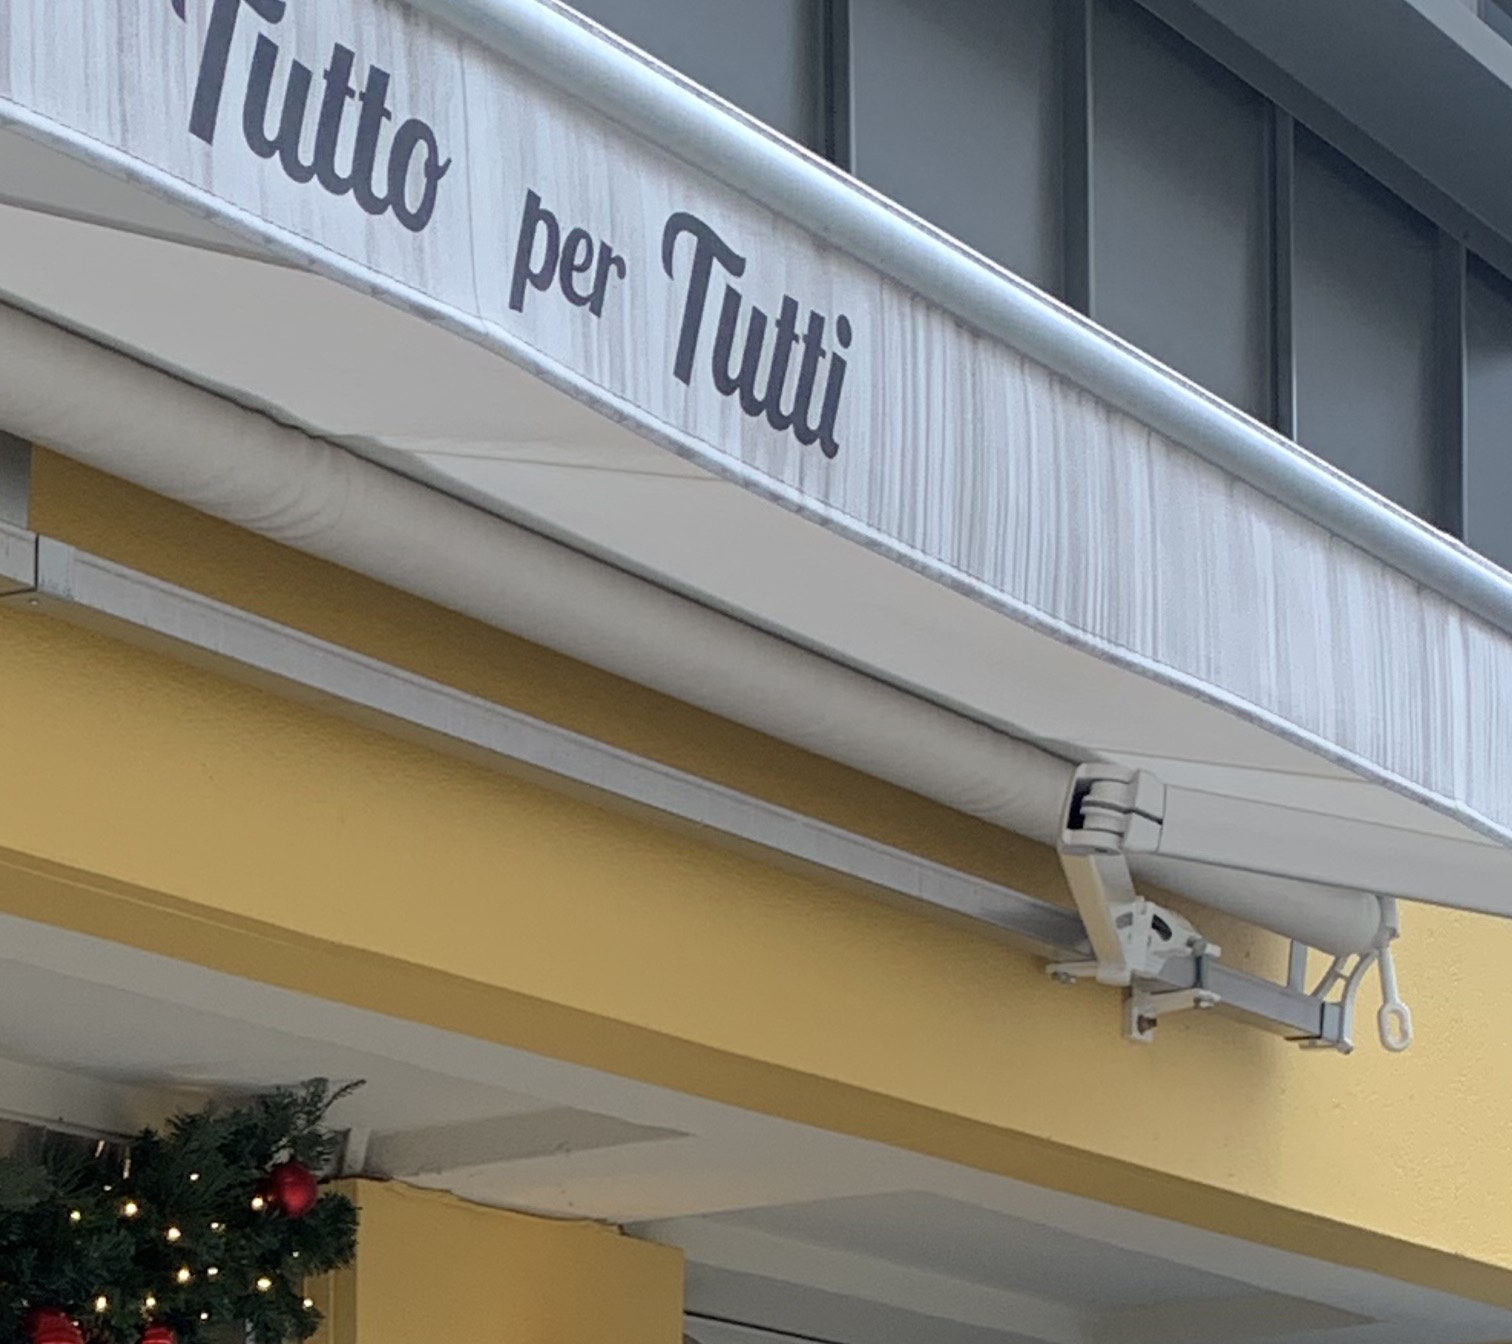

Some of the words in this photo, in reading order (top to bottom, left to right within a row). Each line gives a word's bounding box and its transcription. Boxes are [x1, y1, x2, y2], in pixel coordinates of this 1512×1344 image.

[172, 0, 452, 232] Tutto
[509, 188, 626, 317] per
[662, 211, 852, 458] Tutti
